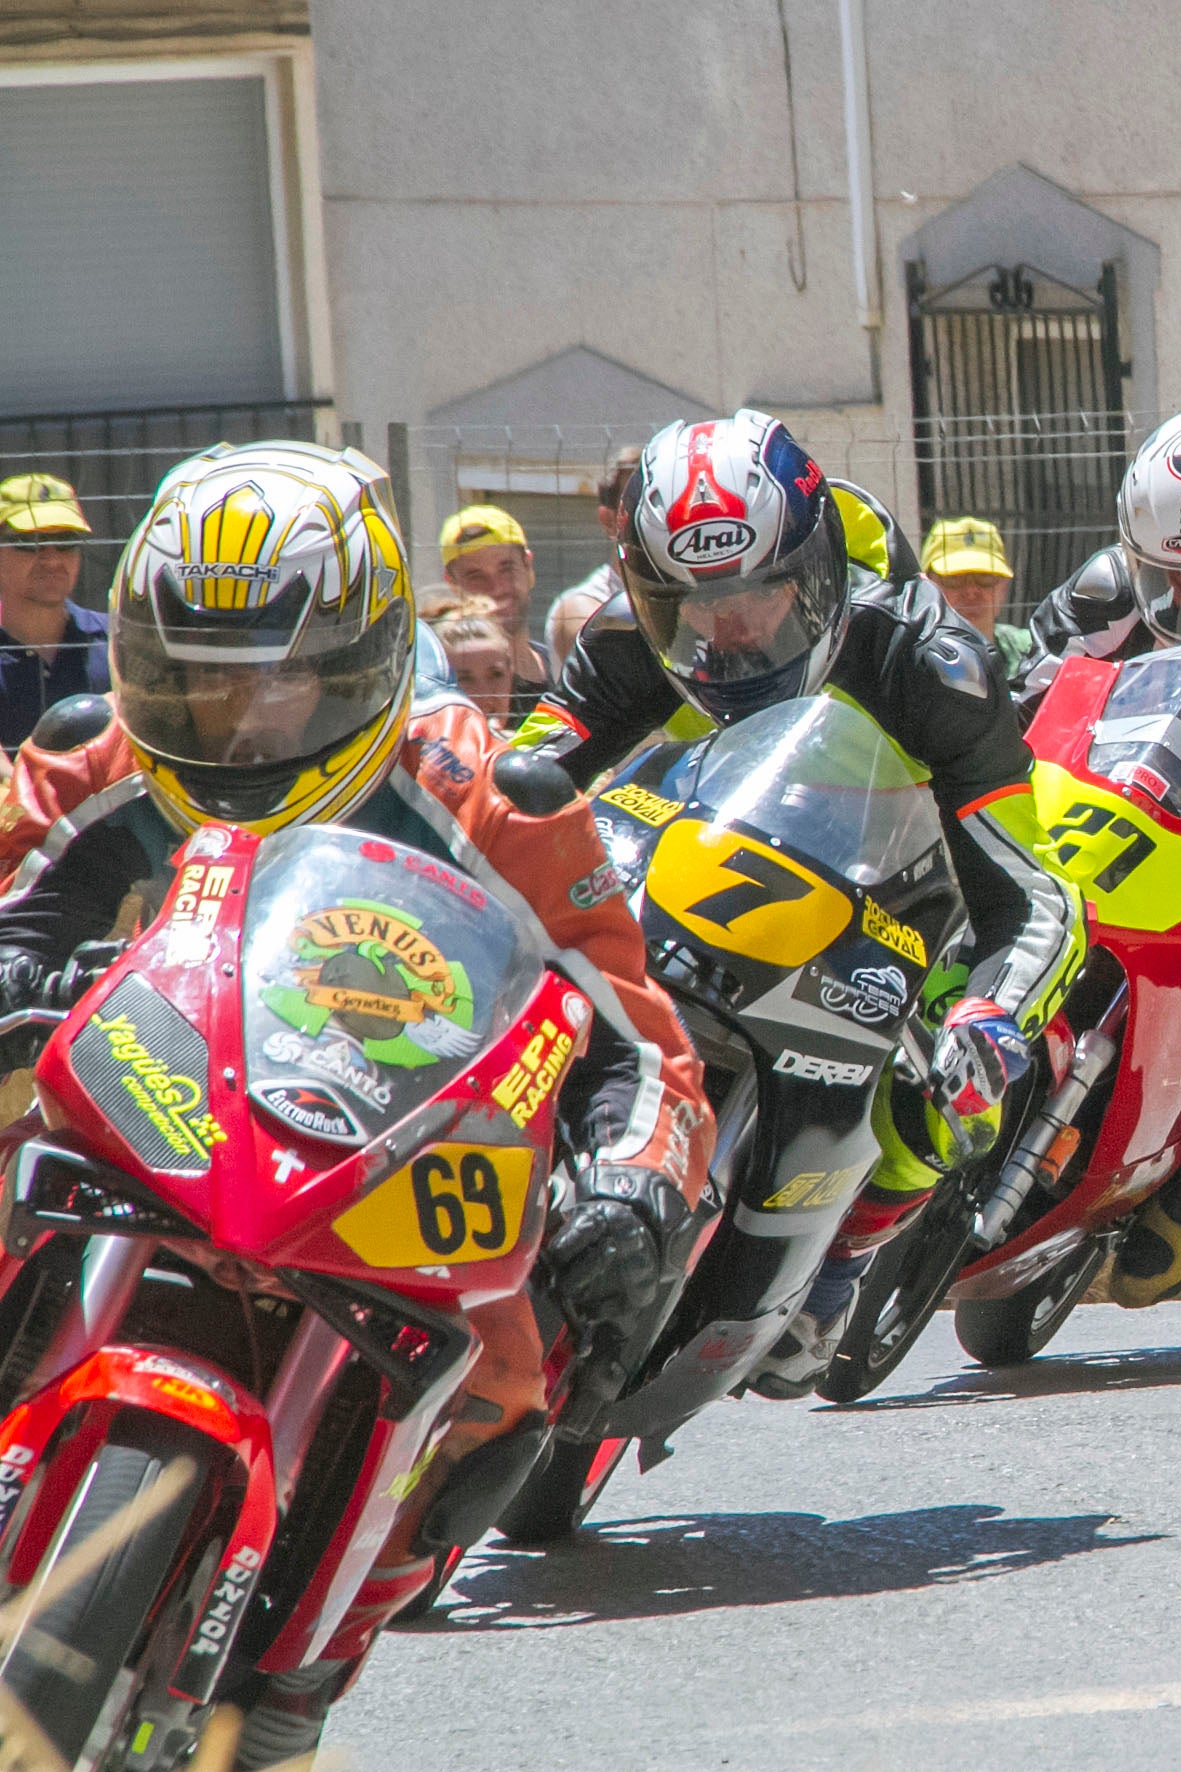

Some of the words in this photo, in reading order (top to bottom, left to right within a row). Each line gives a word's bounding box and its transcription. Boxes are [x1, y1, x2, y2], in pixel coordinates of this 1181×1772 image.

[177, 563, 279, 581] TAKACHI
[673, 523, 748, 558] Arai
[684, 847, 816, 934] 7
[1047, 802, 1156, 894] 27
[313, 912, 437, 967] VENUS
[491, 1018, 559, 1111] EPI
[510, 1032, 573, 1129] RACING
[772, 1048, 874, 1087] DERBI
[411, 1152, 507, 1256] 69
[190, 1545, 262, 1656] DUNLOP
